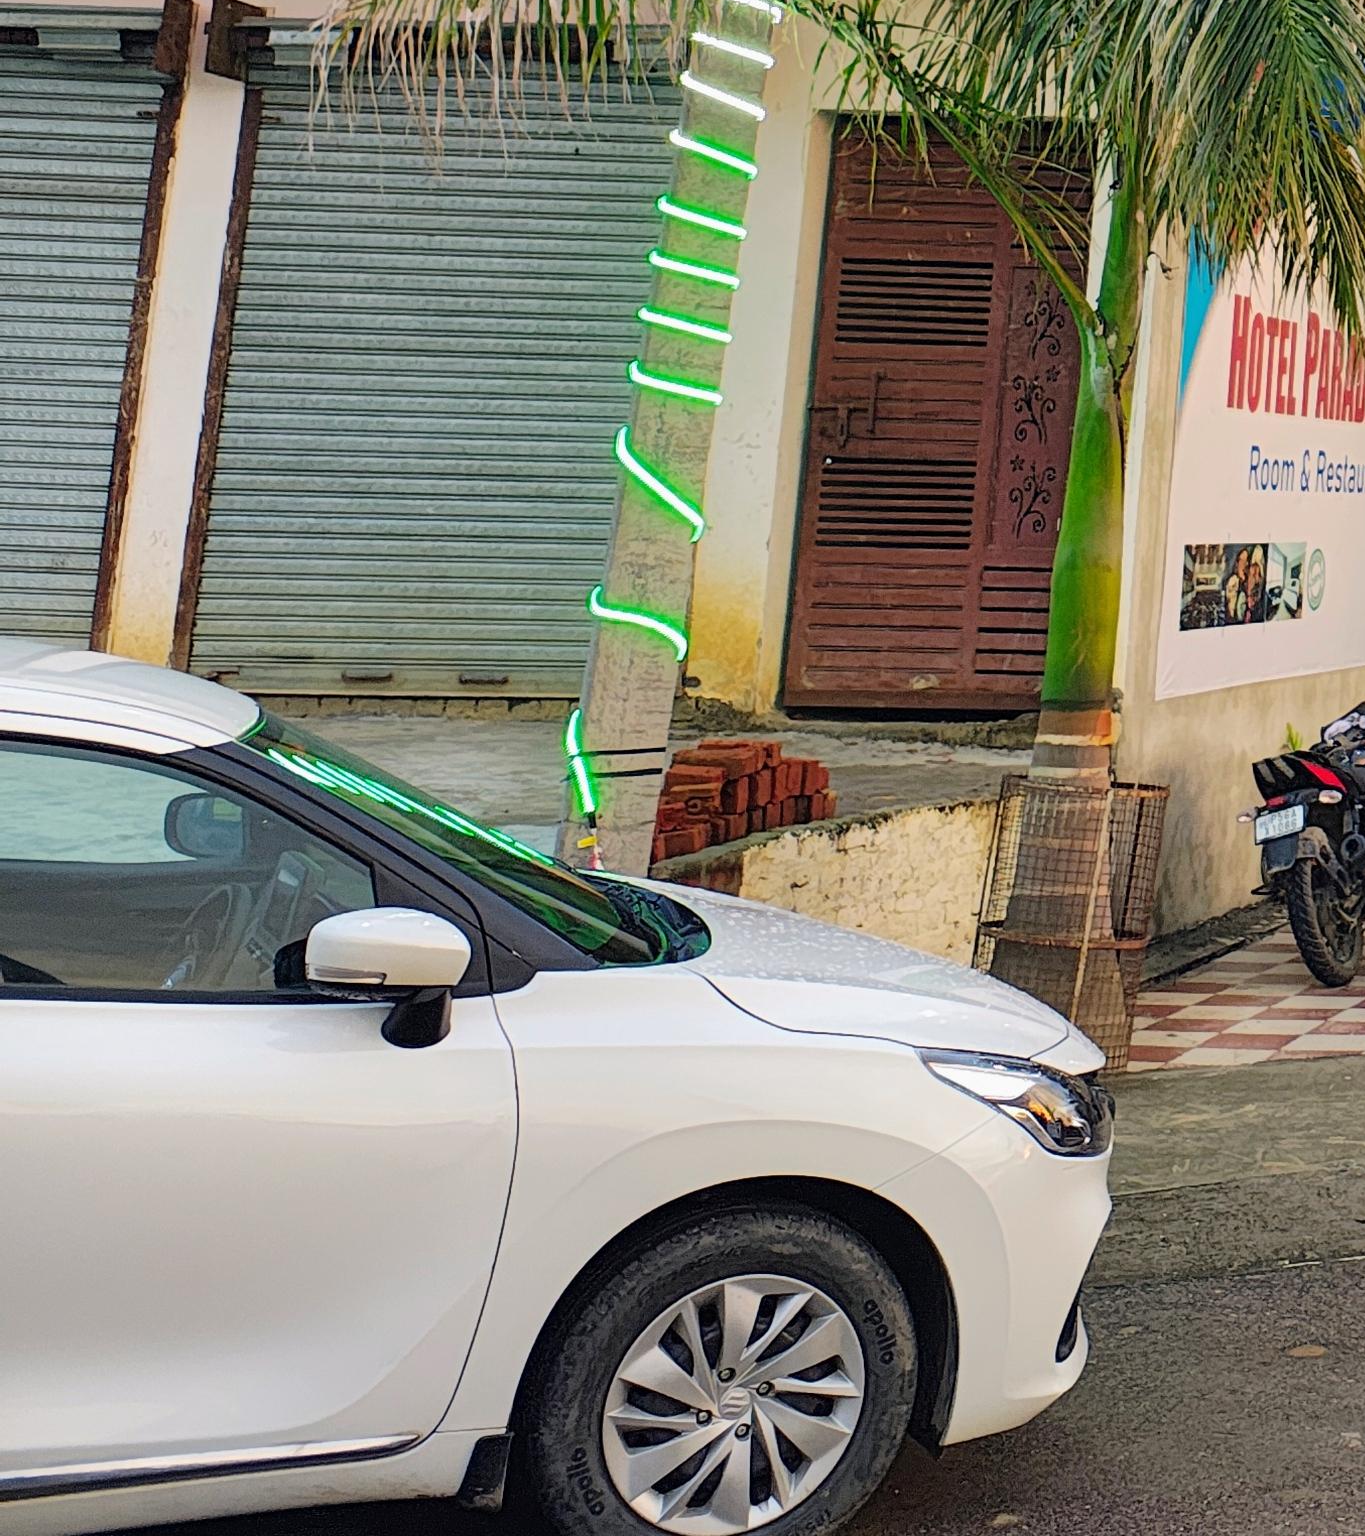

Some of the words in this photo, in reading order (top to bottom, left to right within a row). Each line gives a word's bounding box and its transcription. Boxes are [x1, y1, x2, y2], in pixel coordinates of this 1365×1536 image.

[1227, 293, 1298, 416] HOTEL
[1248, 445, 1295, 492] Room
[1300, 449, 1310, 492] &
[863, 1299, 897, 1365] apollo
[566, 1447, 605, 1516] apollo
